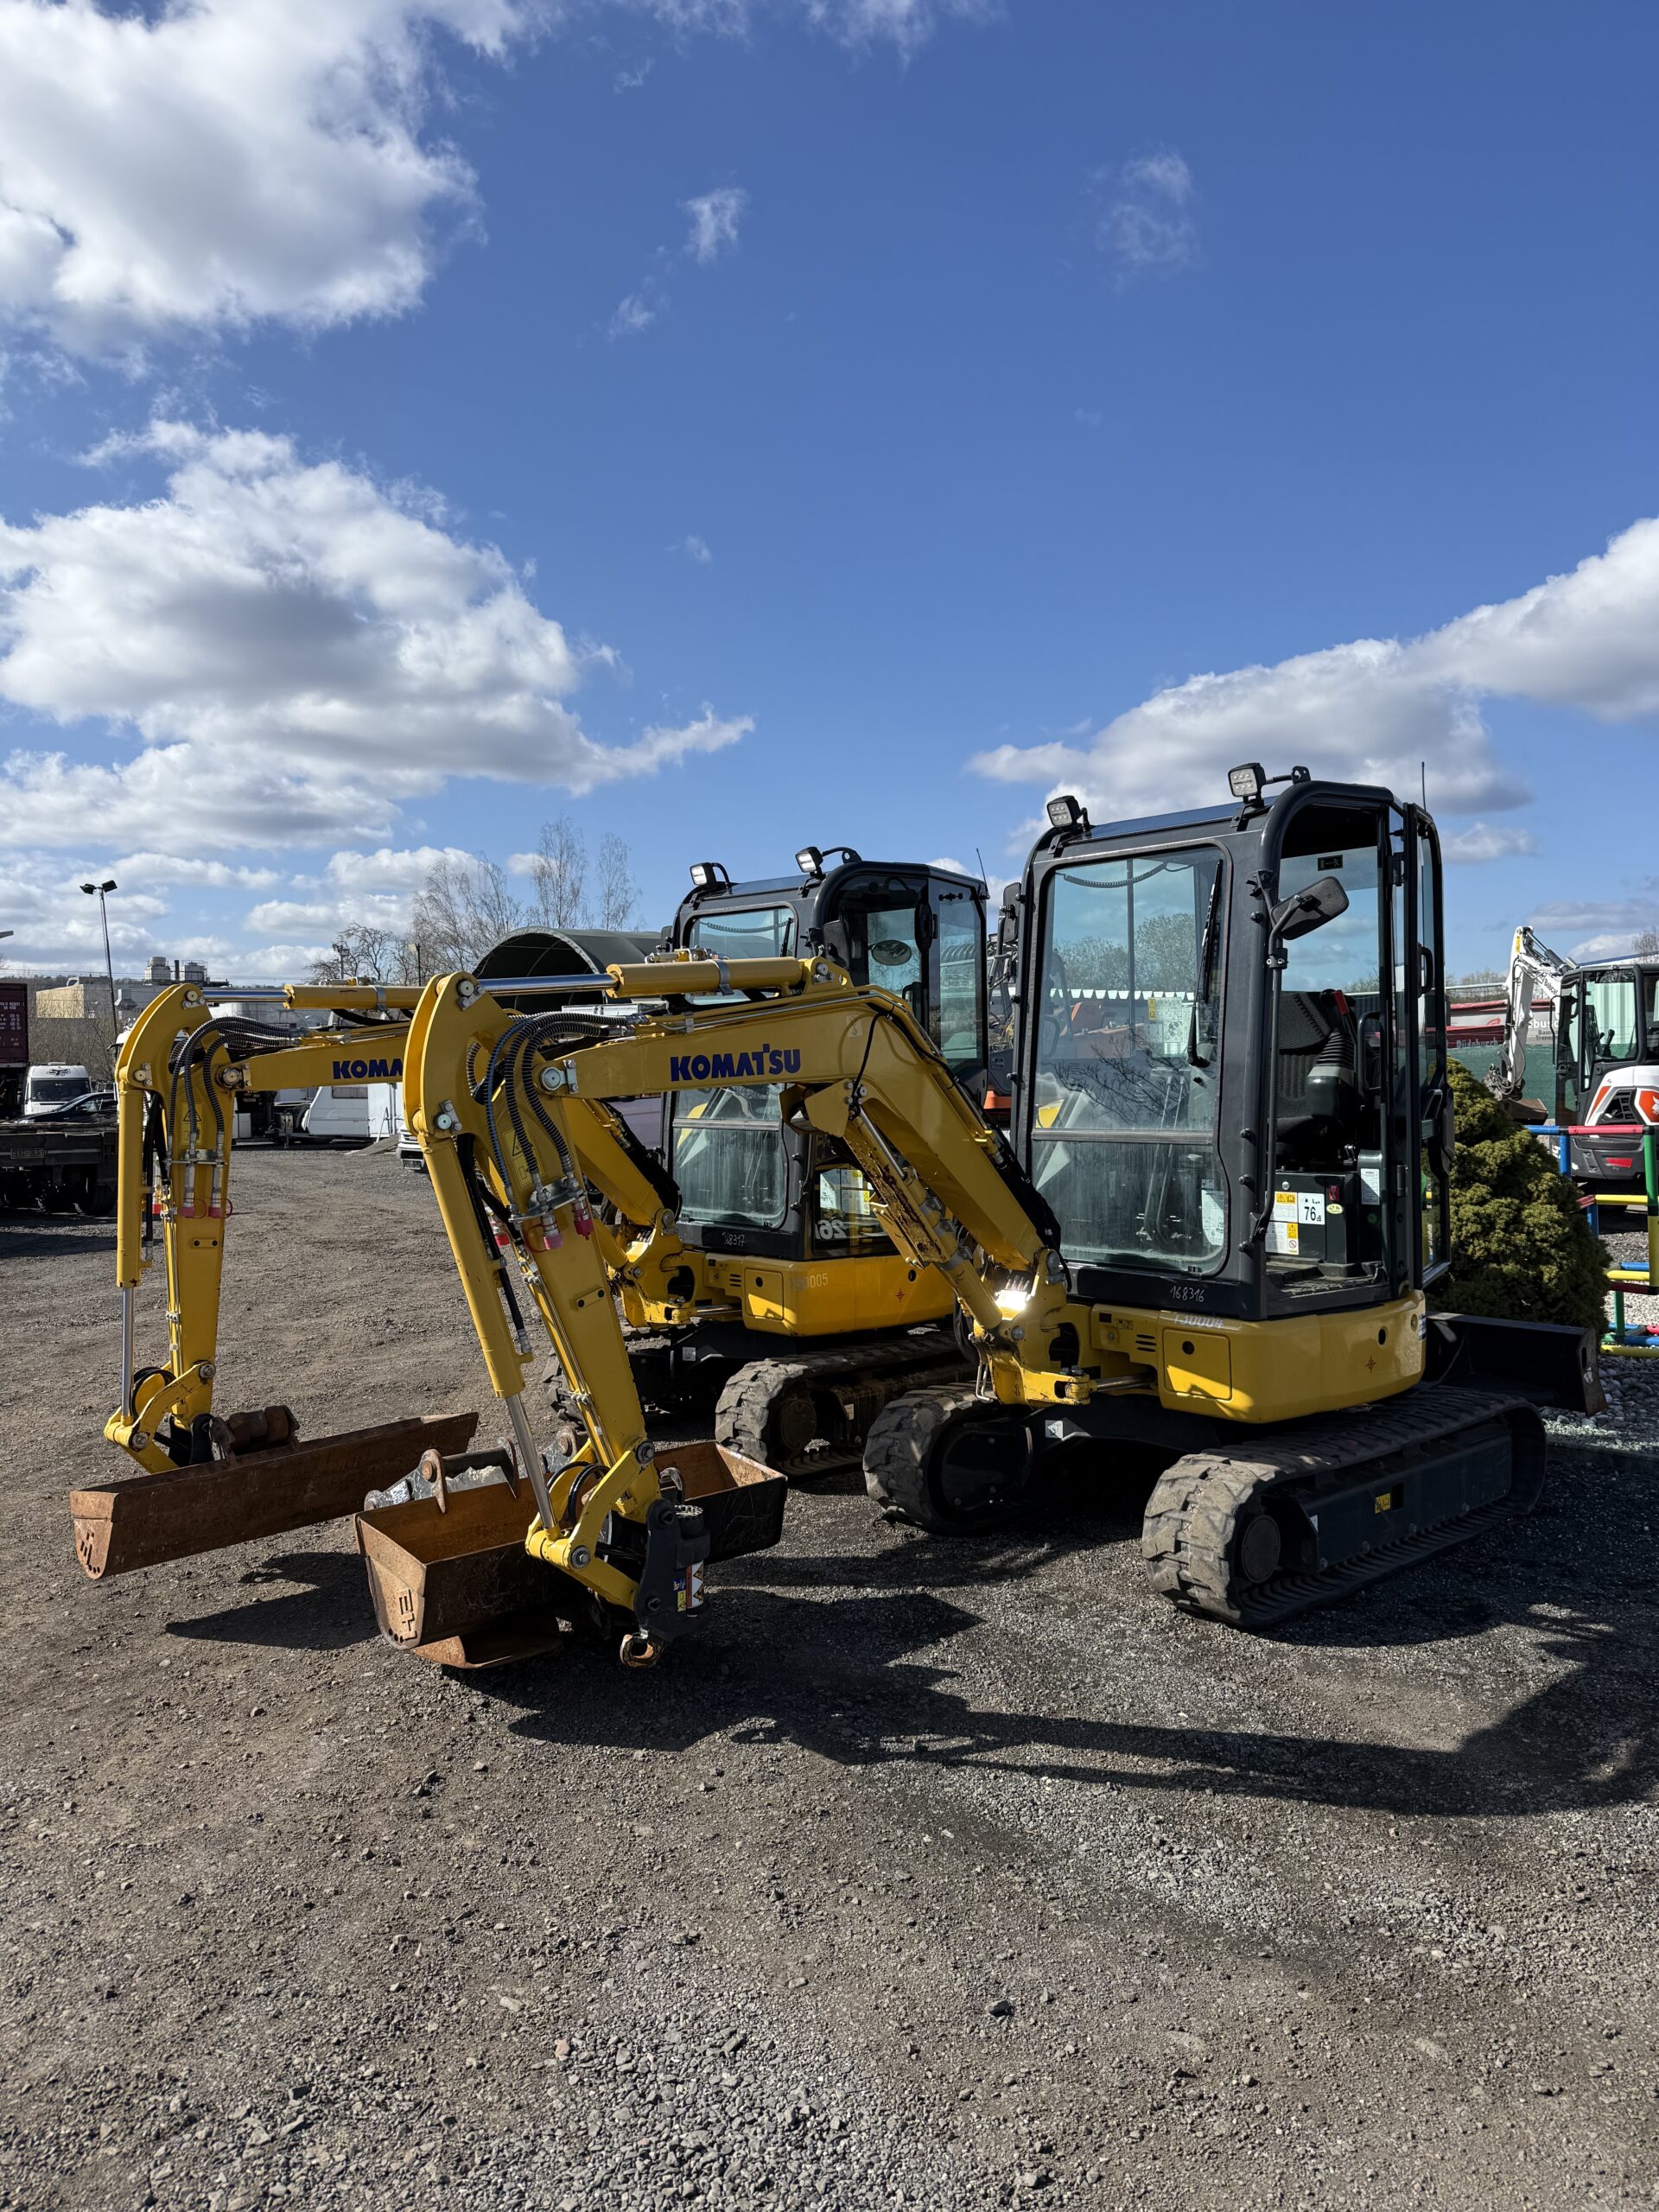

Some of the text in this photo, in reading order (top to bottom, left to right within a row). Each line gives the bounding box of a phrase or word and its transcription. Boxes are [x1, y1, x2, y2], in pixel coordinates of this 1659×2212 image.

[671, 1044, 801, 1081] KOMATSU
[1304, 1206, 1316, 1221] 76
[1170, 1285, 1205, 1302] 168316
